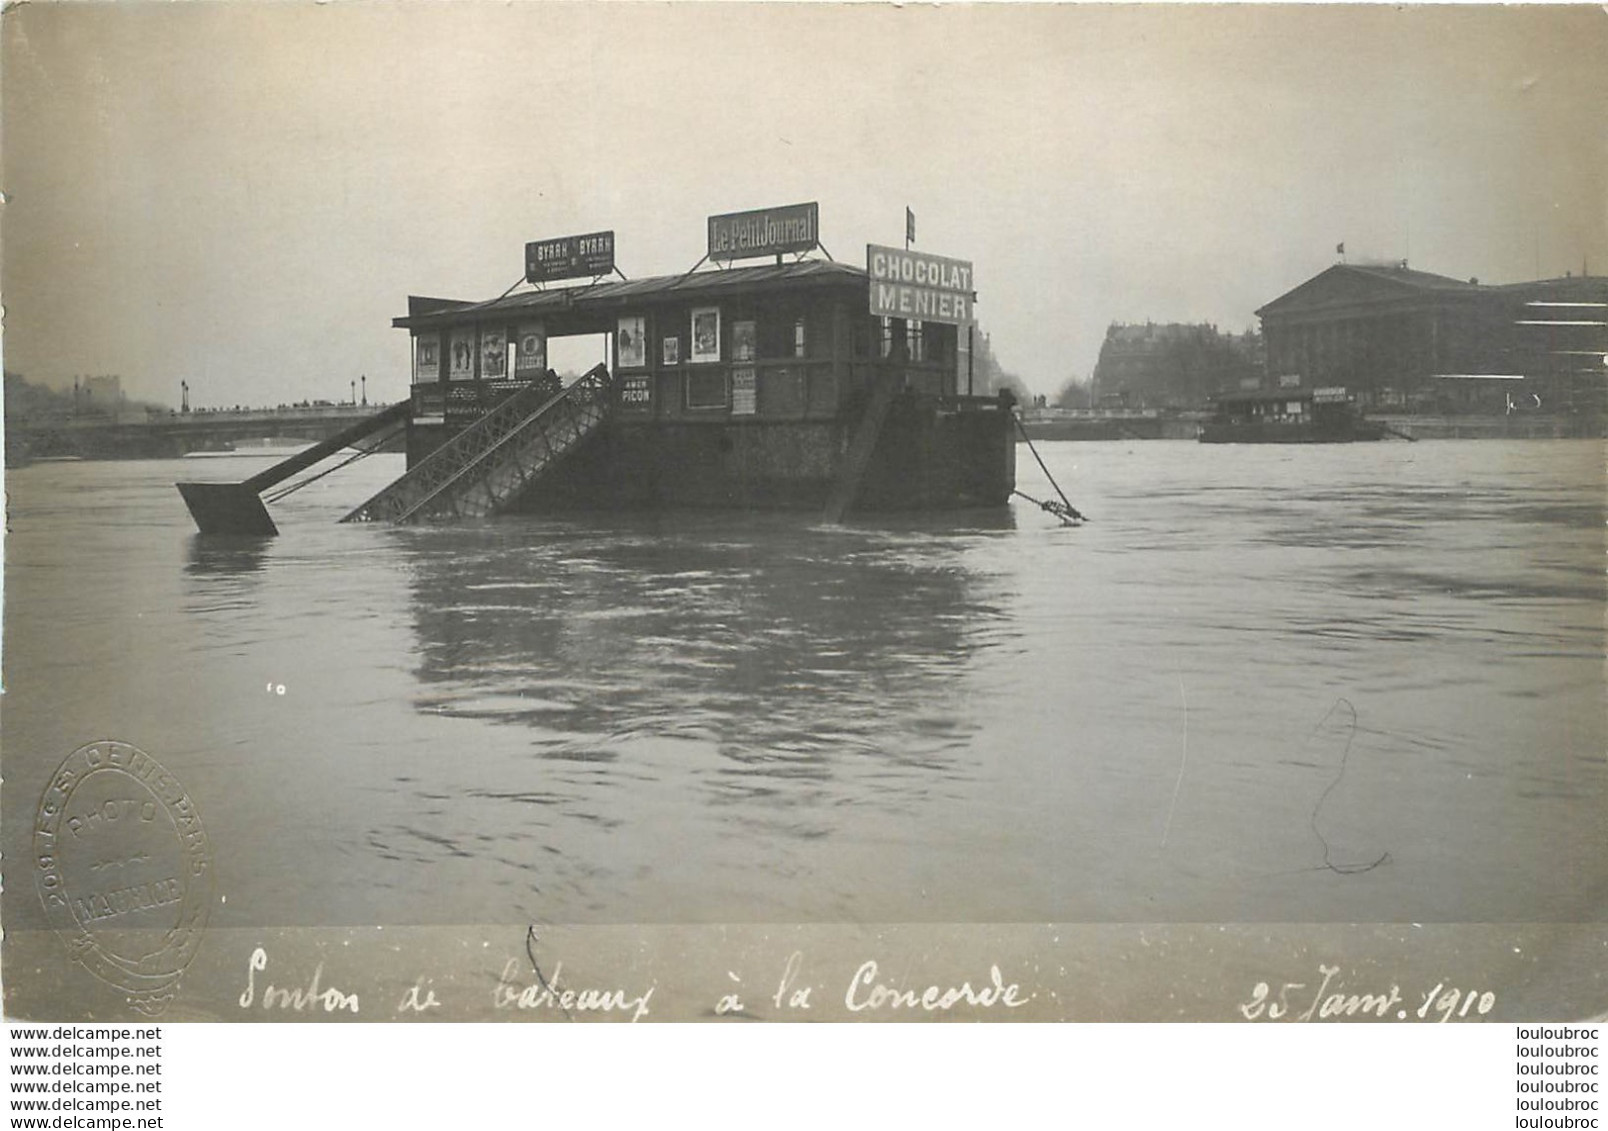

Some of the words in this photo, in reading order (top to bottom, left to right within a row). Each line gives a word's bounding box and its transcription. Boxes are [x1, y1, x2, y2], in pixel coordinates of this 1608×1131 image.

[713, 221, 728, 252] Le
[730, 214, 761, 251] Petit
[761, 208, 812, 246] Journal
[537, 241, 567, 261] BYRRH
[873, 252, 970, 291] CHOCOLAT
[878, 284, 967, 319] MENIER
[622, 390, 650, 402] PICON
[66, 798, 157, 838] PHOTO
[238, 947, 359, 1013] Ponton
[494, 956, 657, 1023] bateaux
[715, 970, 744, 1015] à
[772, 950, 811, 1009] la
[844, 959, 1028, 1013] Concorde
[1241, 981, 1305, 1020] 25
[1416, 982, 1497, 1023] 1910
